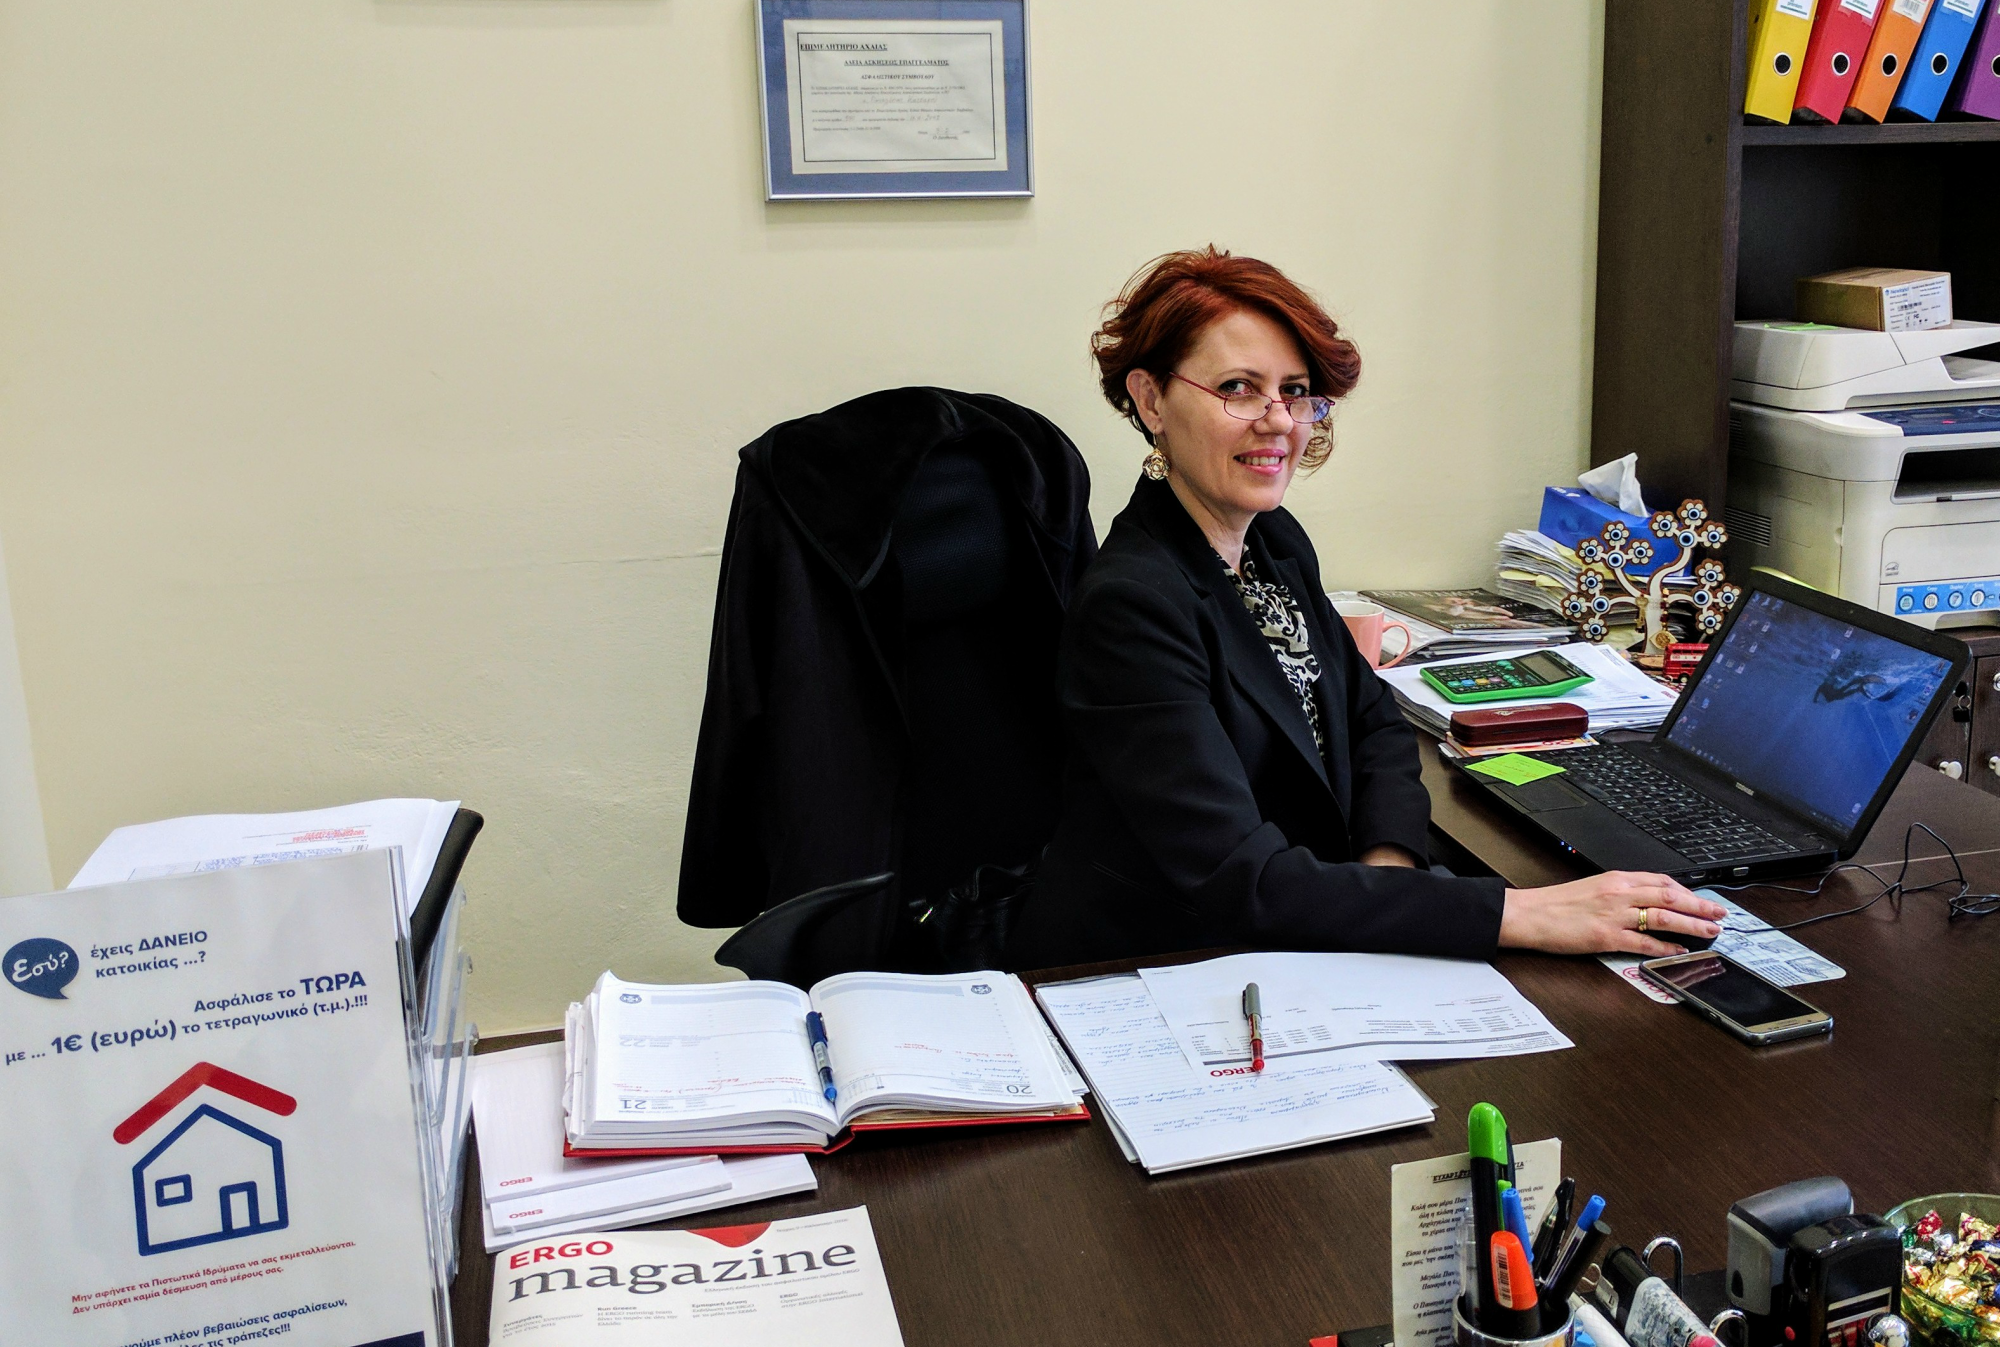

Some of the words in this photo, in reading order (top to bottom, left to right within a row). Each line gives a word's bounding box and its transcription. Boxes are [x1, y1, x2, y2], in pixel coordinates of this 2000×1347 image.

[90, 943, 134, 960] έχεις
[138, 930, 208, 952] ΔΑΝΕΙΟ
[12, 952, 69, 982] Εσύ?
[96, 956, 178, 978] κατοικίας
[194, 991, 273, 1012] Ασφάλισε
[278, 989, 296, 1000] το
[300, 971, 366, 995] ΤΩΡΑ
[6, 1051, 26, 1066] με
[51, 1034, 83, 1054] 1€
[91, 1020, 177, 1052] (ευρώ)
[182, 1024, 200, 1034] το
[205, 1003, 308, 1030] τετραγωνικό
[1210, 1066, 1260, 1077] ERGO
[1006, 1085, 1032, 1094] 20
[620, 1100, 647, 1110] 21
[500, 1176, 532, 1186] ERGO
[509, 1208, 543, 1219] ERGO
[510, 1241, 614, 1270] ERGO
[72, 1294, 92, 1303] Μην
[95, 1284, 136, 1299] αφήνετε
[139, 1282, 150, 1290] τα
[152, 1270, 200, 1287] Πιστωτικά
[203, 1262, 246, 1277] Ιδρύματα
[262, 1256, 278, 1265] σας
[508, 1244, 856, 1302] magazine
[72, 1306, 90, 1314] Δεν
[93, 1298, 132, 1310] υπάρχει
[134, 1290, 160, 1302] καμία
[162, 1281, 208, 1296] δέσμευση
[210, 1276, 228, 1287] από
[230, 1268, 263, 1283] μέρους
[164, 1330, 200, 1344] πλέον
[204, 1314, 270, 1338] βεβαιώσεις
